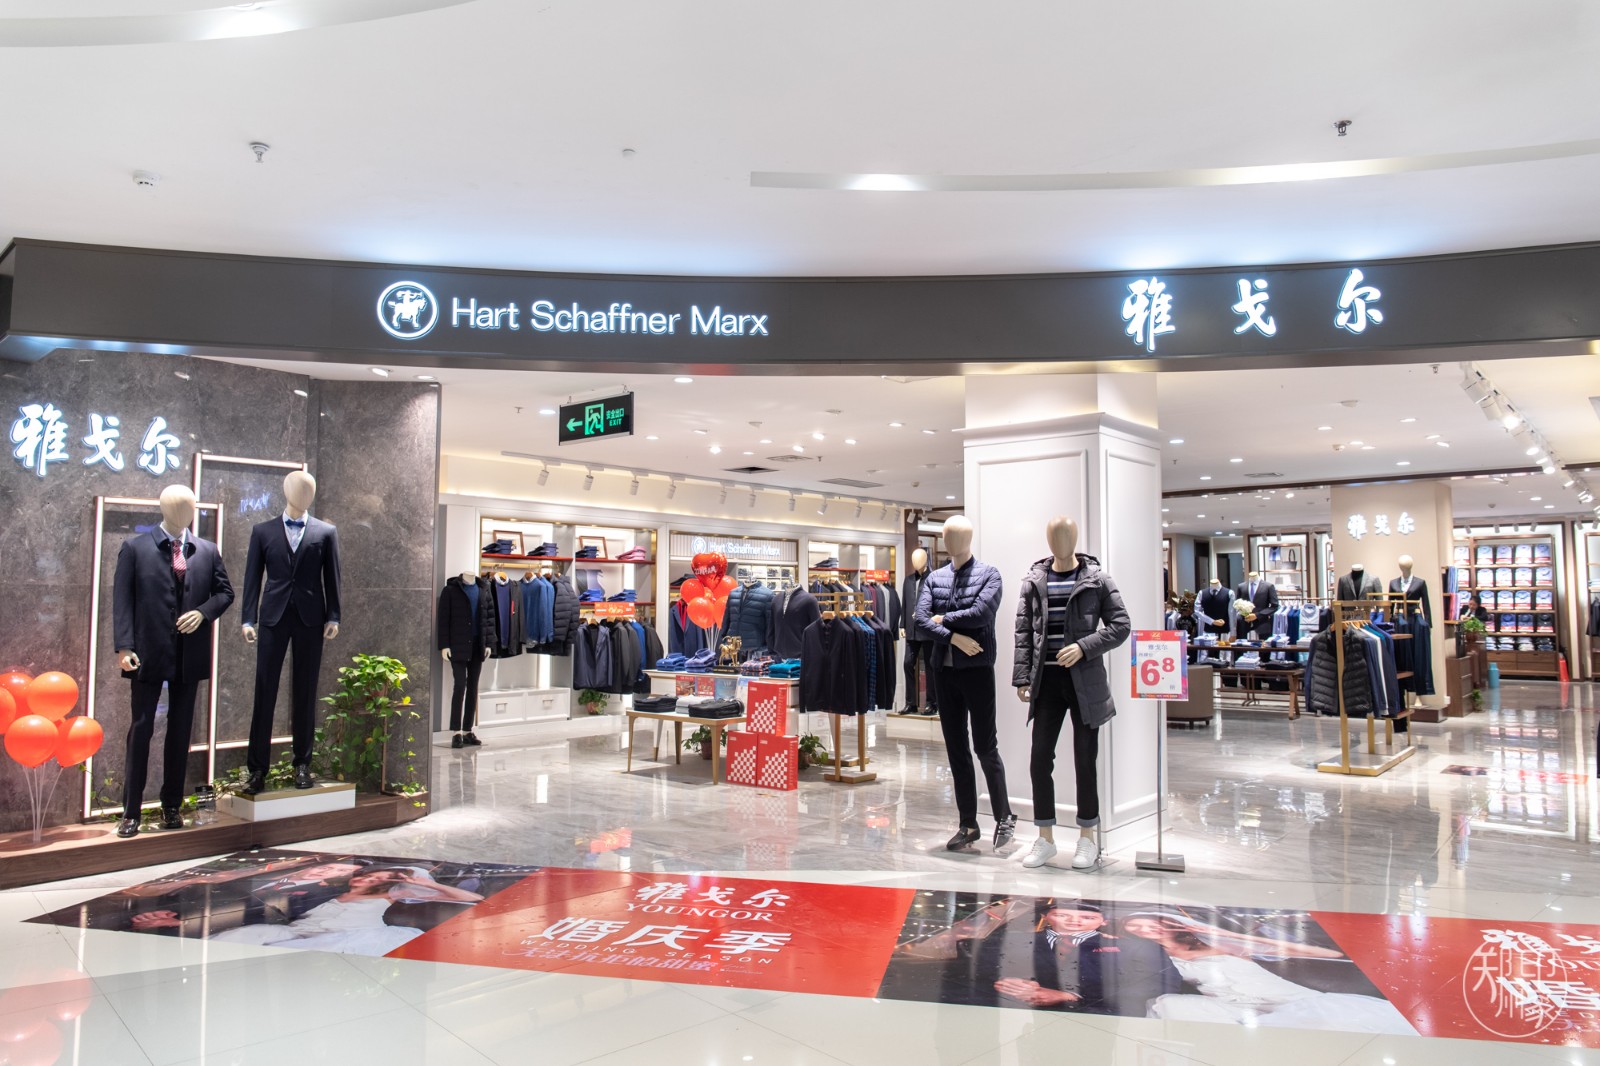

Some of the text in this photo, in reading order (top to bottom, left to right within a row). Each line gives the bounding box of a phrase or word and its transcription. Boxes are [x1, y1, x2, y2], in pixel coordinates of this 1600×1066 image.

[451, 297, 769, 337] Hart Schaffner Marx
[1121, 268, 1384, 352] 雅戈尔
[605, 407, 625, 420] 安全出口
[609, 418, 623, 427] EXIT
[10, 402, 181, 478] 雅戈尔
[634, 882, 790, 908] 雅戈尔
[624, 902, 774, 922] YOUNGOR
[527, 916, 792, 955] 婚庆季
[520, 939, 773, 967] WEDDING SEASON
